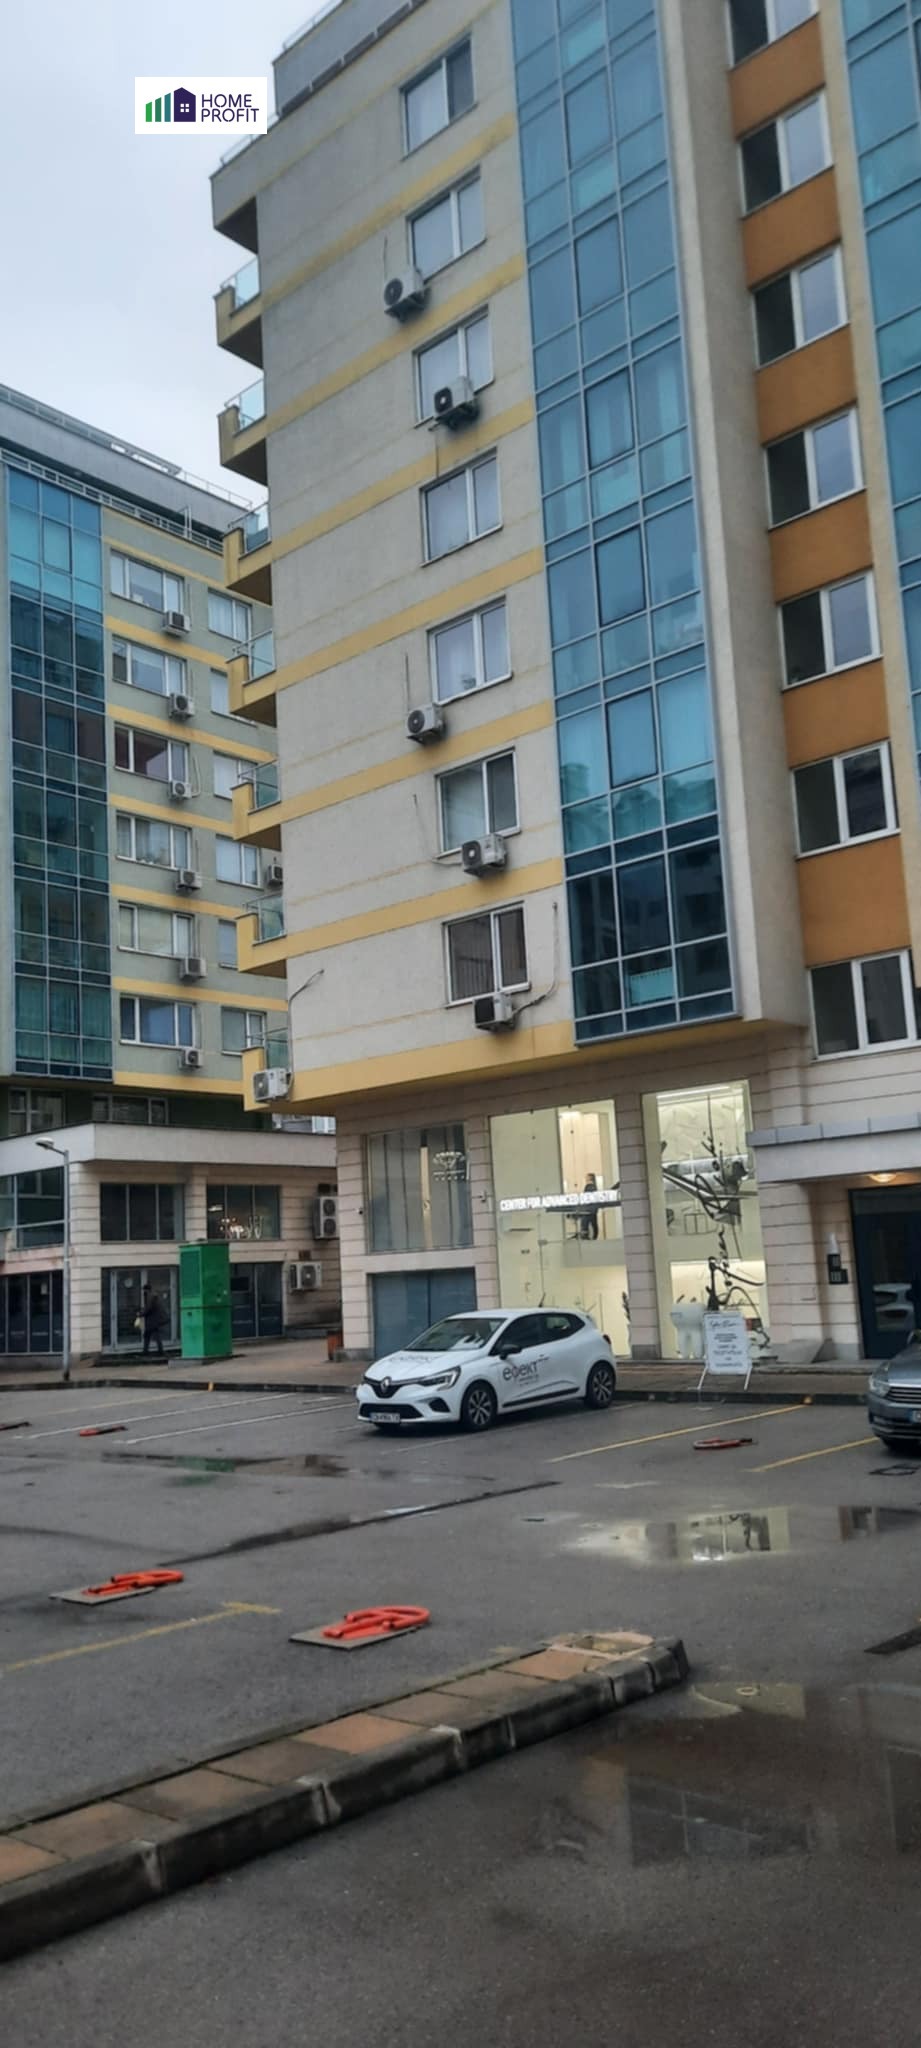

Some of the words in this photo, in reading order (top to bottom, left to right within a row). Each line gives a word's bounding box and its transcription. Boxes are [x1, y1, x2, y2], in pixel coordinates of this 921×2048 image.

[500, 1198, 527, 1212] CENTER
[528, 1196, 541, 1209] FOR
[542, 1192, 580, 1208] ADVANCED
